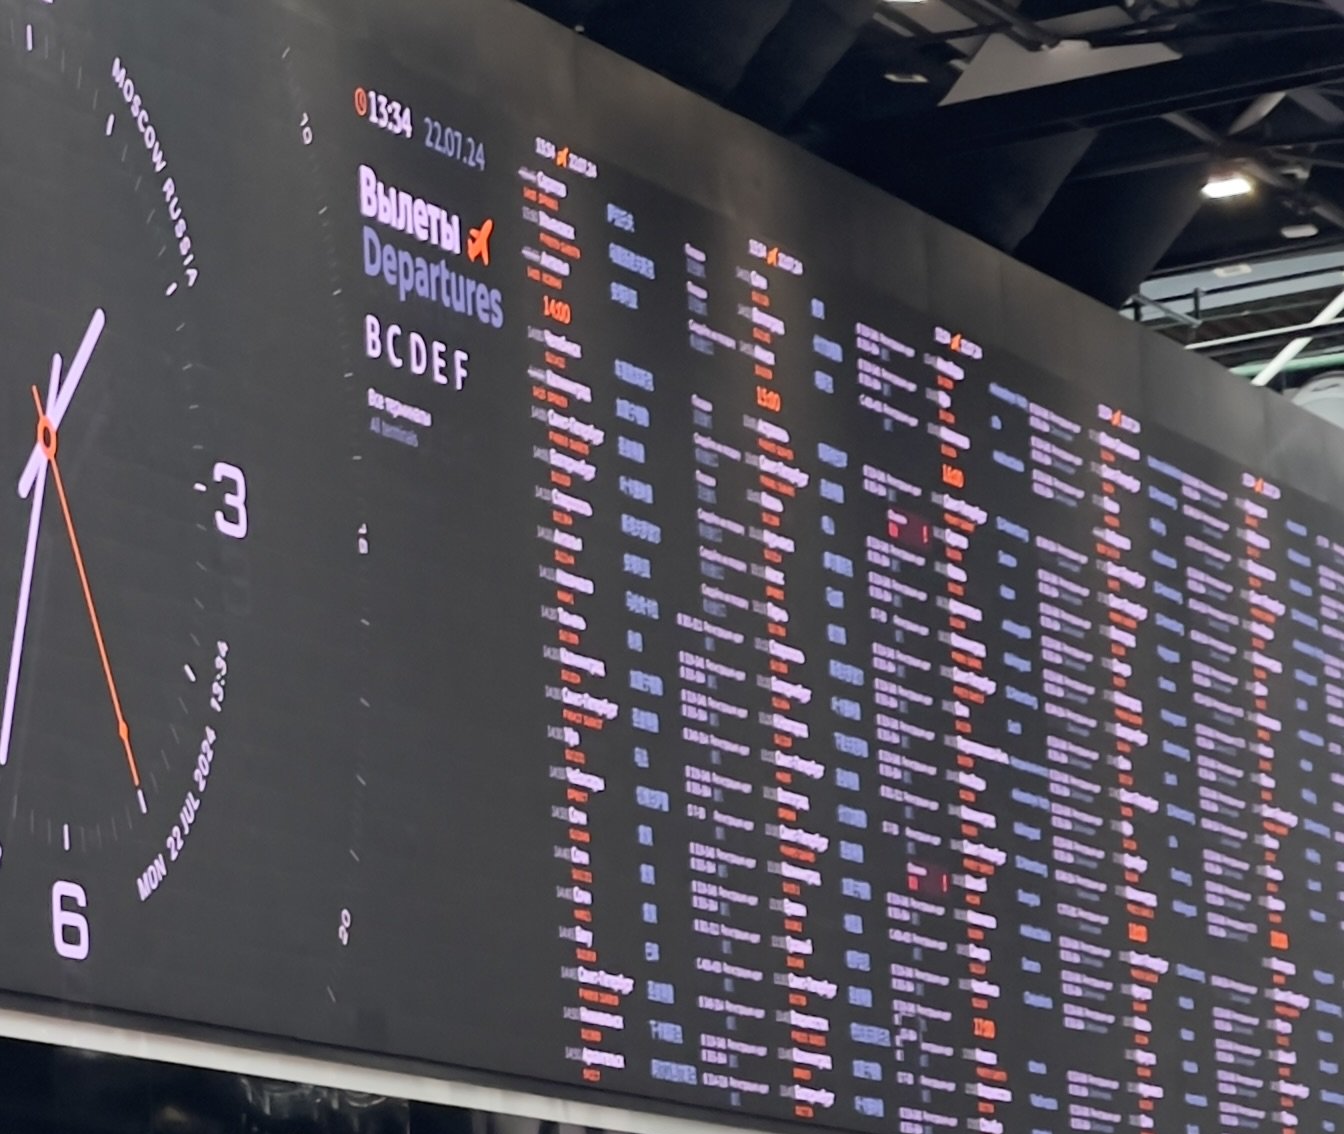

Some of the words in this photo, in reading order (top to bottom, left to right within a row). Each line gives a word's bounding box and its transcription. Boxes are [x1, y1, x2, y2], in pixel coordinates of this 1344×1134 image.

[112, 57, 167, 173] MOSCOW
[163, 177, 198, 287] RUSSIA
[367, 90, 413, 139] 13:34
[424, 117, 486, 171] 22.07.24
[359, 164, 461, 255] Вылеты
[362, 225, 504, 329] Departures
[365, 313, 382, 360] B
[387, 324, 403, 369] C
[409, 331, 428, 376] D
[432, 340, 448, 386] E
[454, 349, 469, 391] F
[214, 462, 247, 538] 3
[136, 852, 168, 902] MON
[166, 825, 185, 862] 22
[179, 791, 201, 835] JUL
[193, 725, 217, 793] 2024
[50, 879, 91, 961] 6
